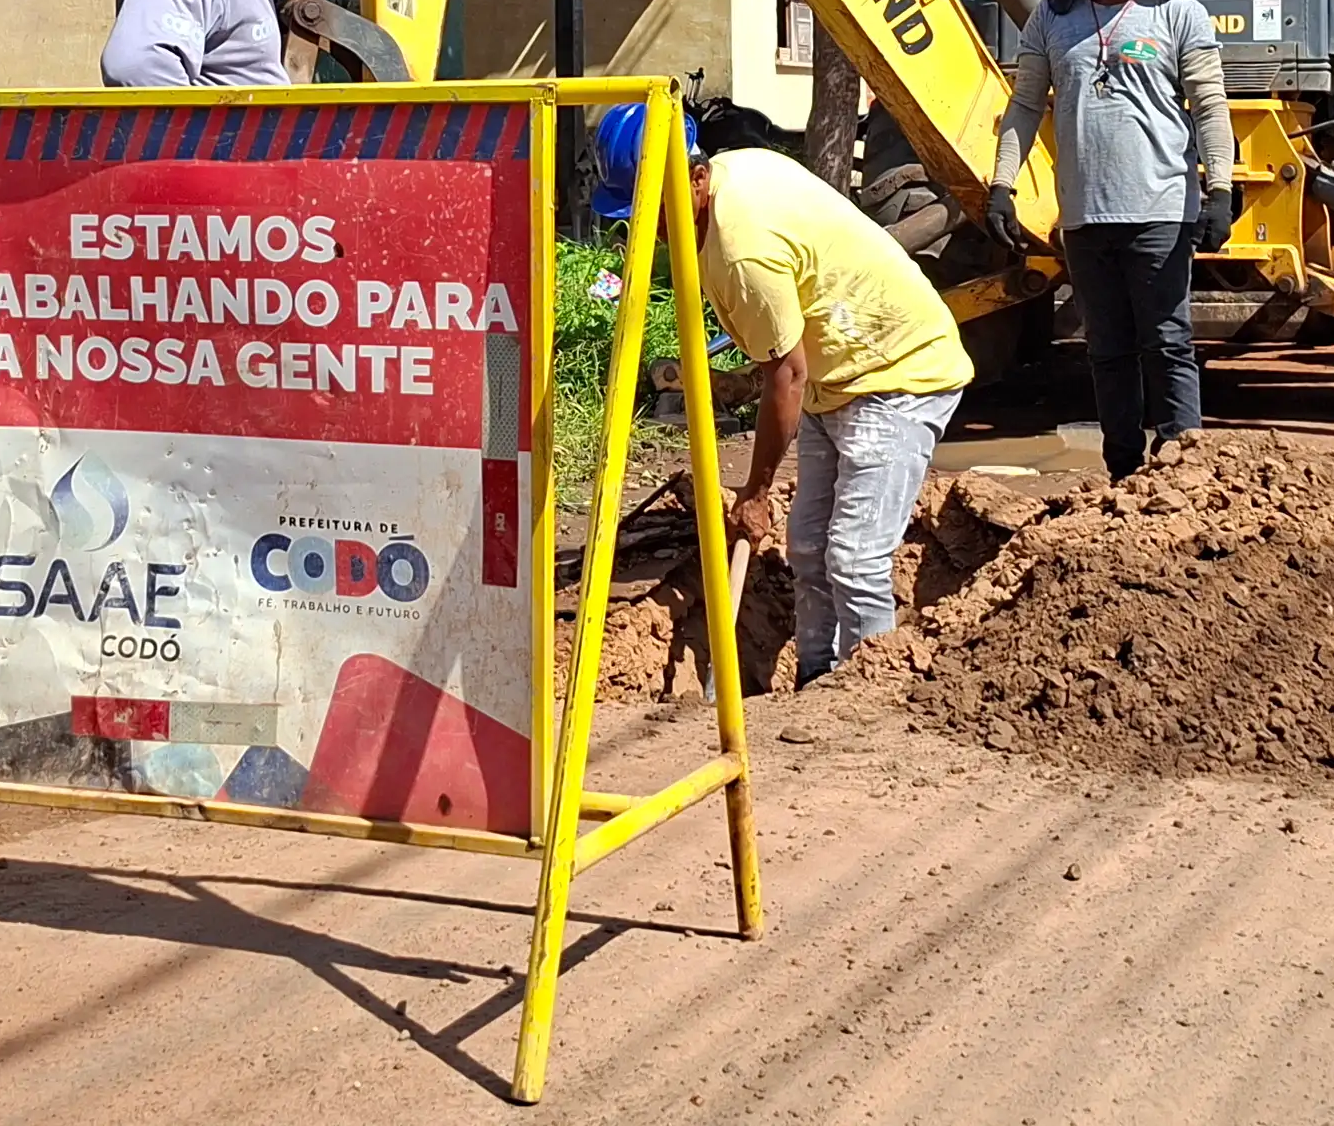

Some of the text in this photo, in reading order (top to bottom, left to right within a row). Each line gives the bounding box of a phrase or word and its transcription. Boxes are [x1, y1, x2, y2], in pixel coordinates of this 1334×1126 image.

[70, 214, 336, 263] ESTAMOS
[356, 280, 519, 332] PARA
[35, 334, 226, 386] NOSSA
[236, 340, 434, 395] GENTE
[279, 516, 399, 534] PREFEITURA DE
[250, 533, 430, 602] CODÓ
[283, 599, 351, 614] TRABALHO
[356, 605, 363, 615] E
[369, 607, 421, 620] FUTURO
[101, 634, 181, 662] CODÓ
